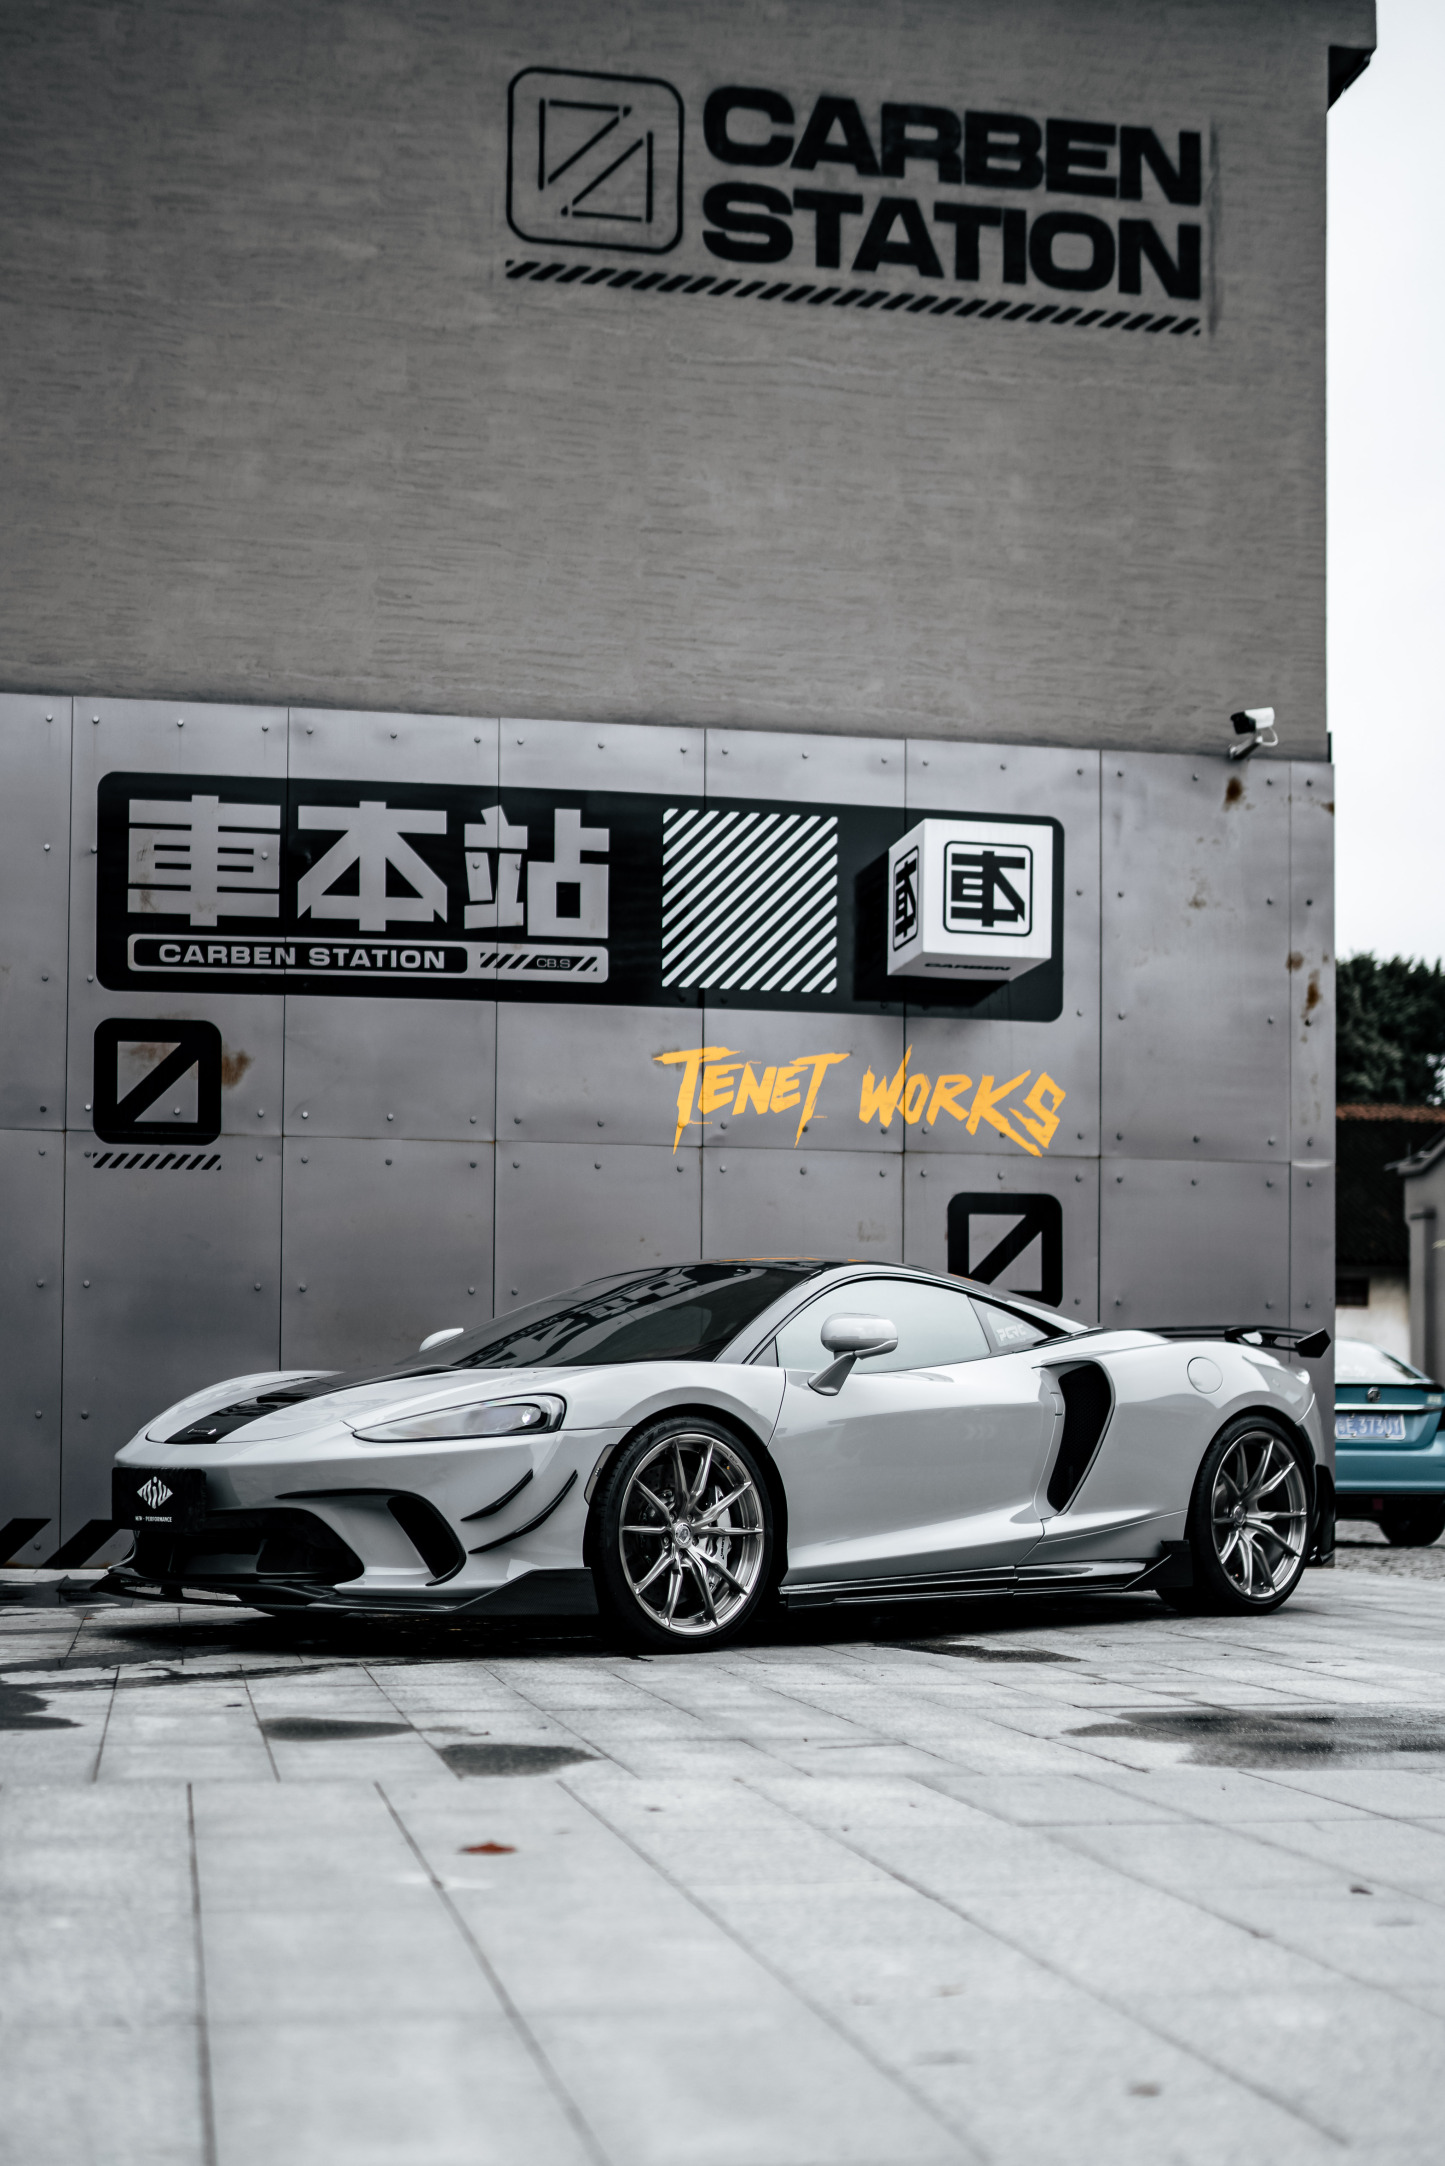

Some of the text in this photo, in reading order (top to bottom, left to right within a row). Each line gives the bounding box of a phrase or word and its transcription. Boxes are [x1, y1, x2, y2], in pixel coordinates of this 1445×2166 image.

[703, 85, 1202, 207] CARBEN
[702, 181, 1202, 301] STATION
[127, 794, 610, 939] 車本站
[158, 943, 446, 970] CARBEN STATION
[536, 958, 571, 969] CB.S
[653, 1044, 1066, 1157] TENET WORKS
